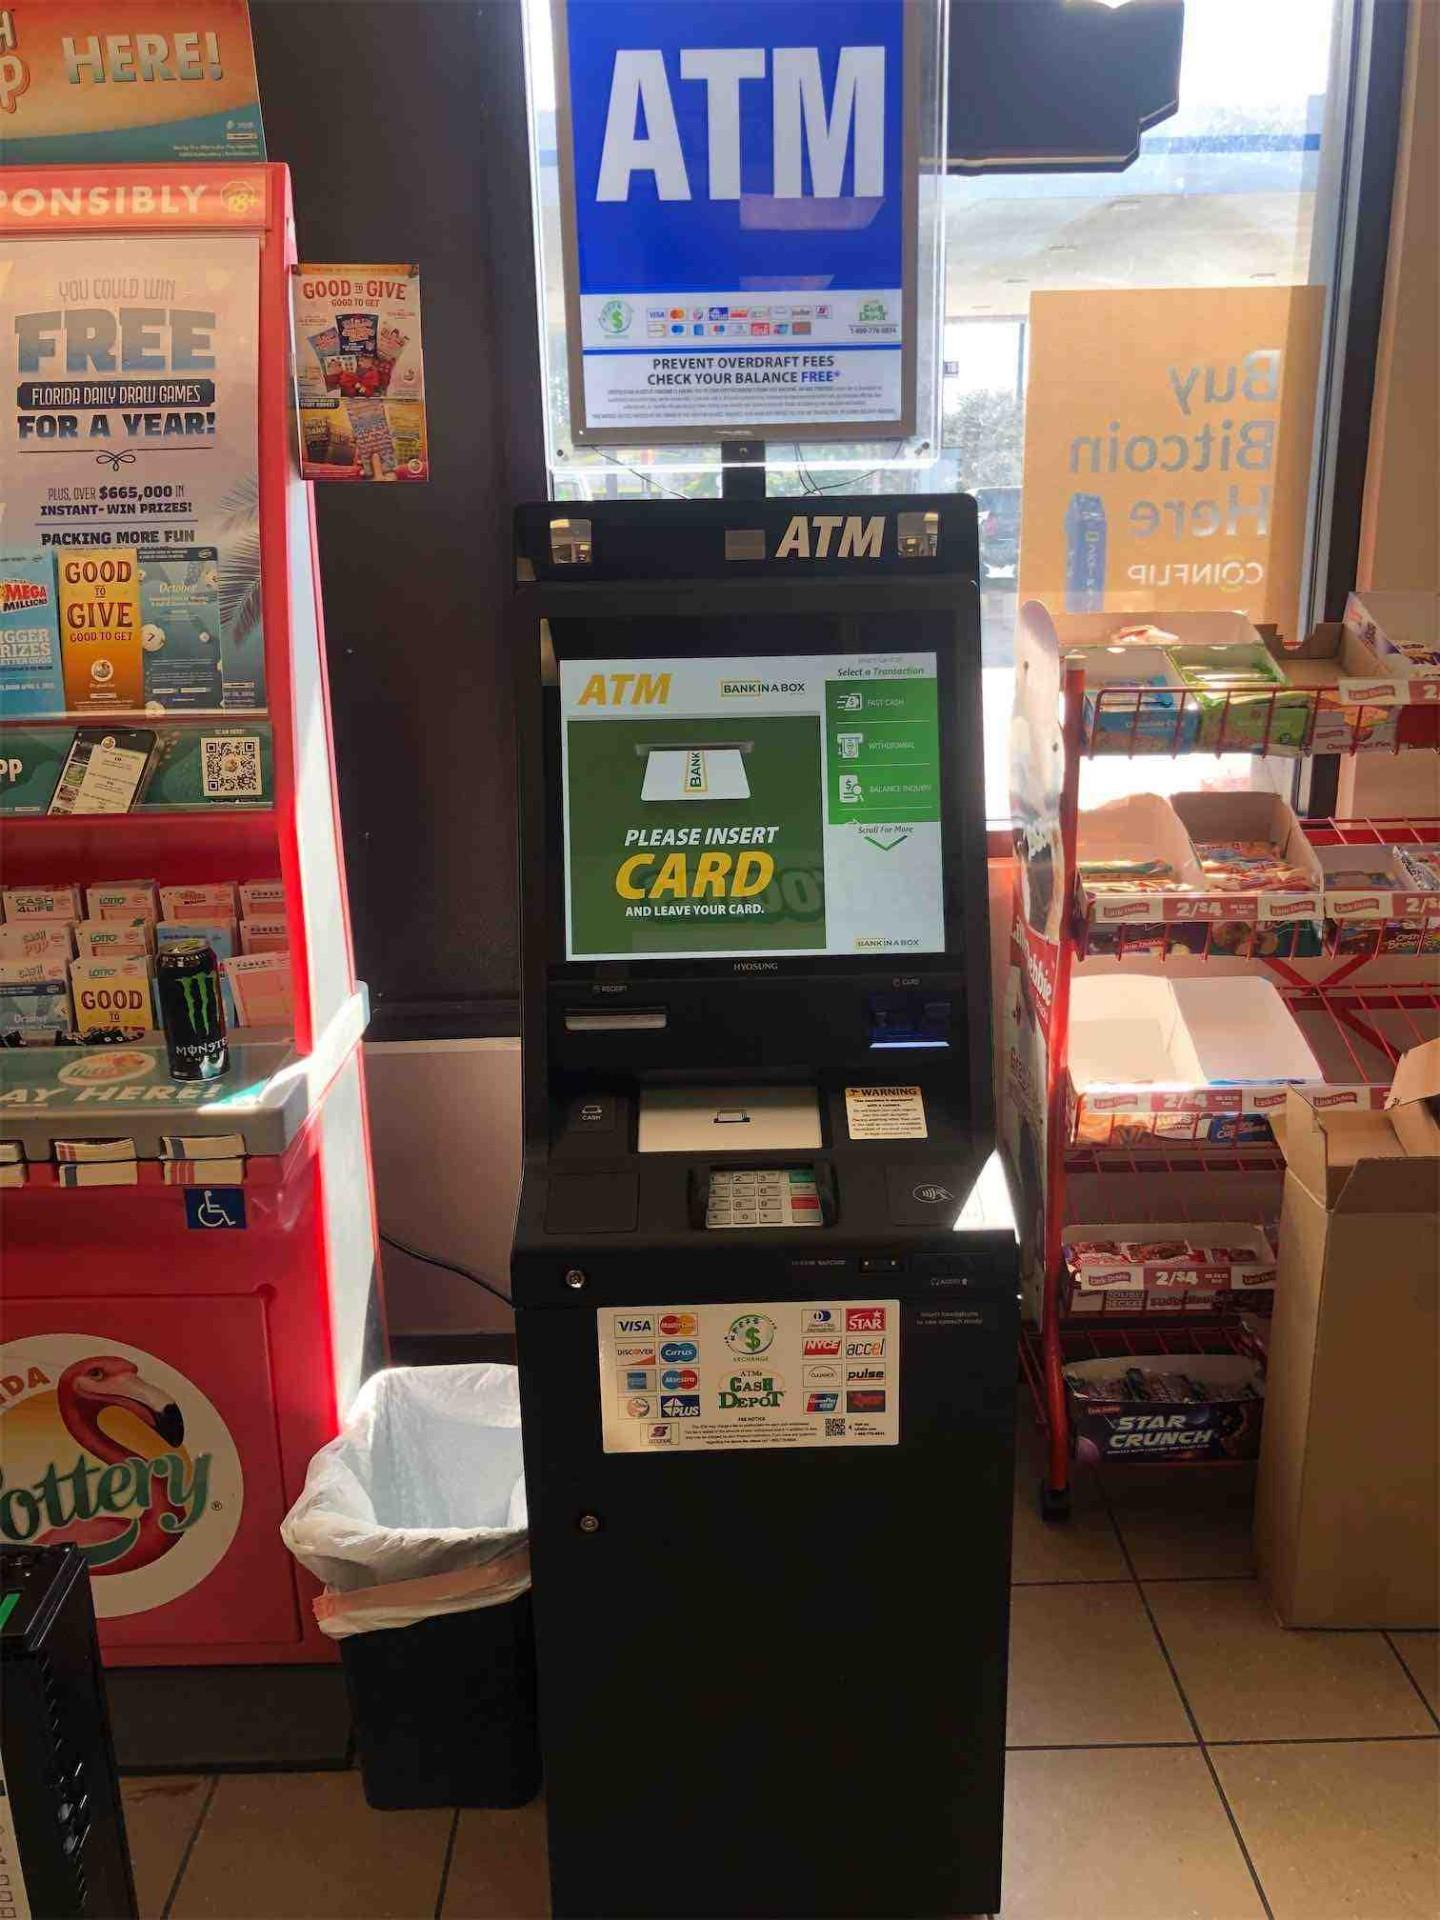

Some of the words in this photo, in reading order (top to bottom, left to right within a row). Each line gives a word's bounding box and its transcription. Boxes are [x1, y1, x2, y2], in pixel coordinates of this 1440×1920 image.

[61, 32, 224, 85] HERE!
[596, 46, 886, 203] ATM
[0, 184, 208, 217] ONSIBLY
[57, 280, 87, 301] YOU
[93, 278, 140, 300] COULD
[143, 278, 176, 300] WIN
[303, 280, 351, 300] GOOD
[366, 280, 407, 300] GIVE
[14, 307, 216, 375] FREE
[653, 358, 714, 370] PREVENT
[717, 356, 800, 369] OVERDRAFT
[802, 355, 835, 367] FEES
[647, 373, 692, 386] CHECK
[695, 373, 732, 385] YOUR
[735, 371, 798, 384] BALANCE
[31, 387, 81, 406] FLORIDA
[83, 386, 117, 405] DAILY
[118, 385, 158, 404] DRAW
[159, 384, 202, 404] GAMES
[17, 414, 79, 439] FOR
[89, 414, 111, 438] A
[121, 411, 217, 437] YEAR!
[47, 487, 72, 502] PLUS,
[74, 486, 97, 501] OVER
[98, 484, 173, 503] $665,000
[175, 484, 185, 498] IN
[139, 502, 193, 515] PRIZES!
[41, 532, 112, 546] PACKING
[116, 531, 160, 545] MORE
[164, 530, 196, 543] FUN
[774, 515, 887, 560] ATM
[64, 560, 132, 584] GOOD
[5, 582, 48, 600] MEGA
[95, 586, 106, 597] TO
[66, 602, 133, 629] GIVE
[70, 632, 97, 643] GOOD
[100, 632, 112, 641] TO
[114, 631, 133, 641] GET
[837, 668, 863, 677] Select
[873, 667, 925, 676] Transaction
[576, 673, 673, 706] ATM
[723, 684, 756, 694] BANK
[690, 752, 702, 788] BANK
[624, 827, 702, 847] PLEASE
[704, 826, 780, 845] INSERT
[858, 826, 879, 834] Scroll
[894, 825, 915, 833] More
[615, 851, 776, 900] CARD
[625, 906, 652, 917] AND
[654, 905, 691, 917] LEAVE
[693, 904, 726, 916] YOUR
[728, 903, 765, 915] CARD.
[1176, 901, 1223, 917] 2/$4
[734, 962, 778, 971] HYOSUNG
[80, 989, 143, 1010] GOOD
[73, 1083, 223, 1102] HERE!
[861, 1088, 917, 1097] WARNING
[1155, 1270, 1199, 1285] 2/$4
[618, 1320, 652, 1332] VISA
[849, 1318, 882, 1330] STAR
[617, 1348, 654, 1356] DISCOVER
[665, 1348, 694, 1357] Cirrus
[806, 1340, 840, 1350] NYCE
[846, 1338, 885, 1356] accel
[0, 1365, 50, 1400] DA
[847, 1368, 885, 1381] pulse
[729, 1377, 774, 1393] CASH
[718, 1391, 785, 1409] DEPOT
[672, 1405, 700, 1417] PLUS
[1116, 1415, 1188, 1431] STAR
[1109, 1429, 1214, 1448] CRUNCH
[0, 1453, 212, 1545] ottery
